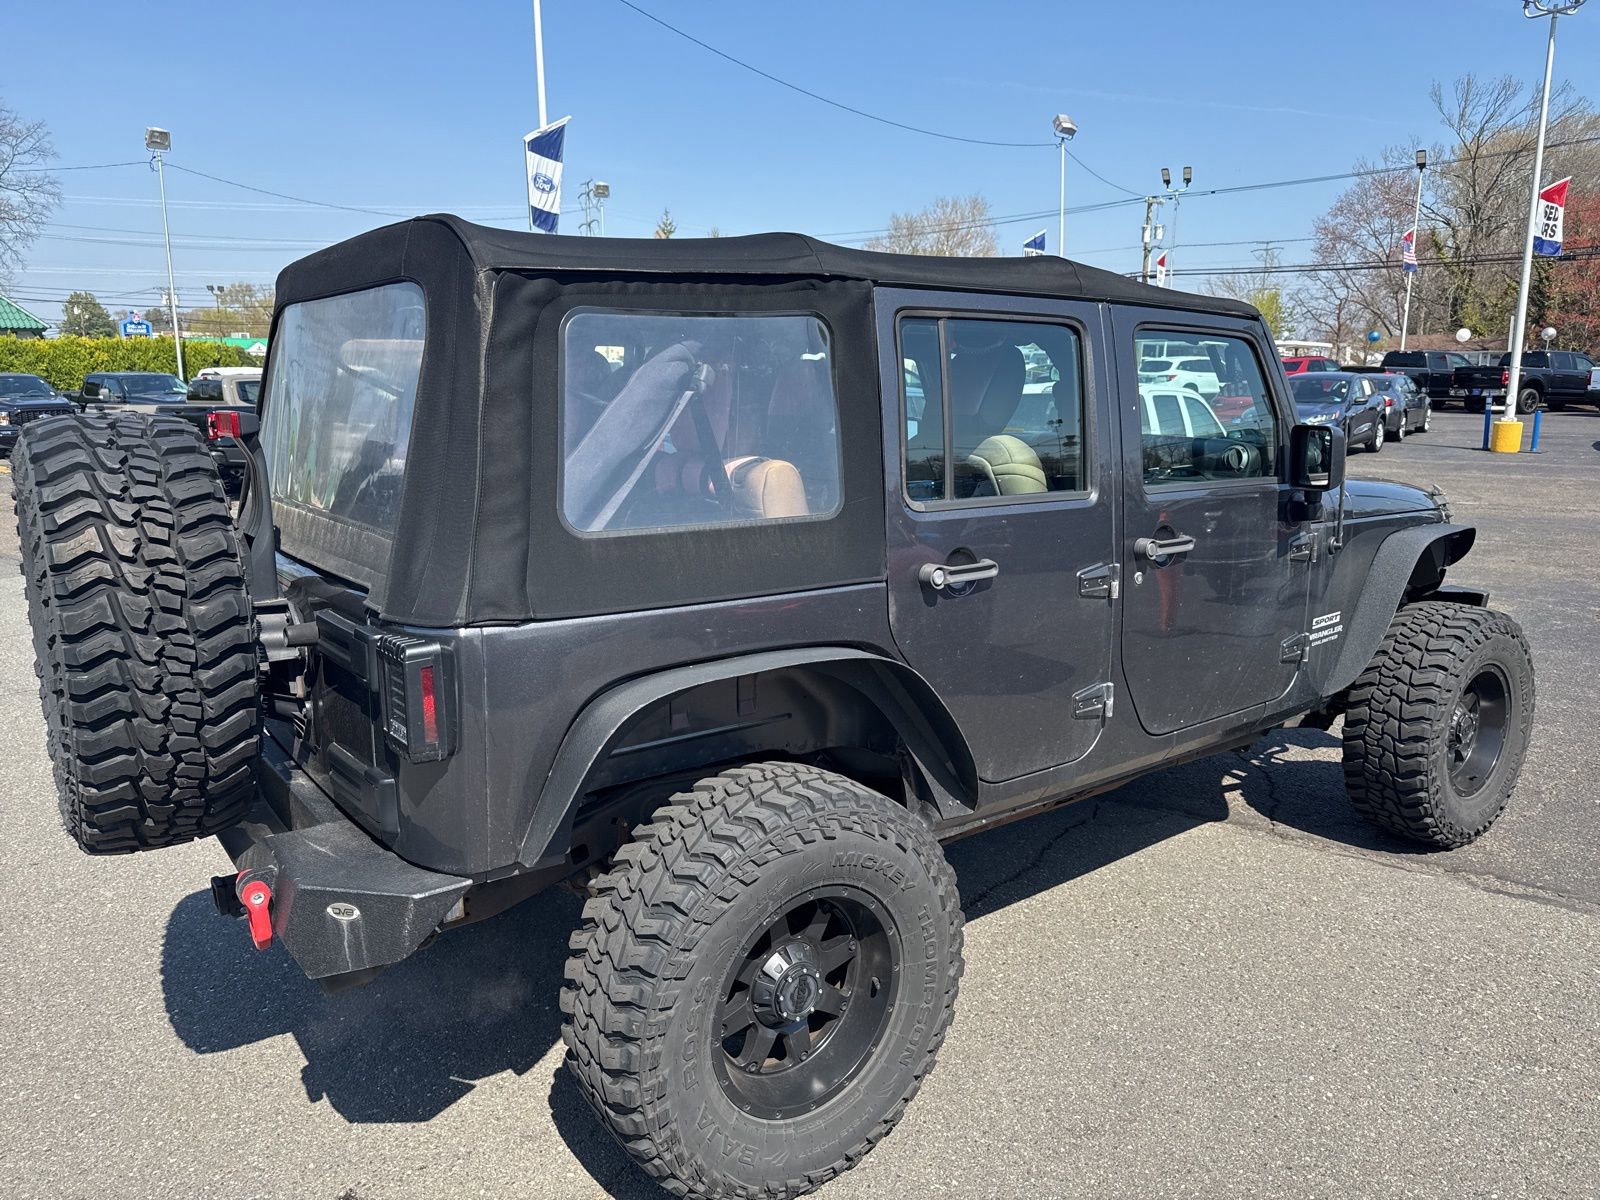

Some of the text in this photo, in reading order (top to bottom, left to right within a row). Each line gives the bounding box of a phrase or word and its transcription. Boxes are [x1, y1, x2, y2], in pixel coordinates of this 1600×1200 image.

[1543, 204, 1559, 221] SED
[1541, 222, 1558, 239] RS
[1313, 614, 1340, 627] SPORT
[1309, 624, 1344, 641] WRANGLER
[832, 850, 939, 1068] MICKEY THOMPSON
[695, 1099, 761, 1169] BAJA
